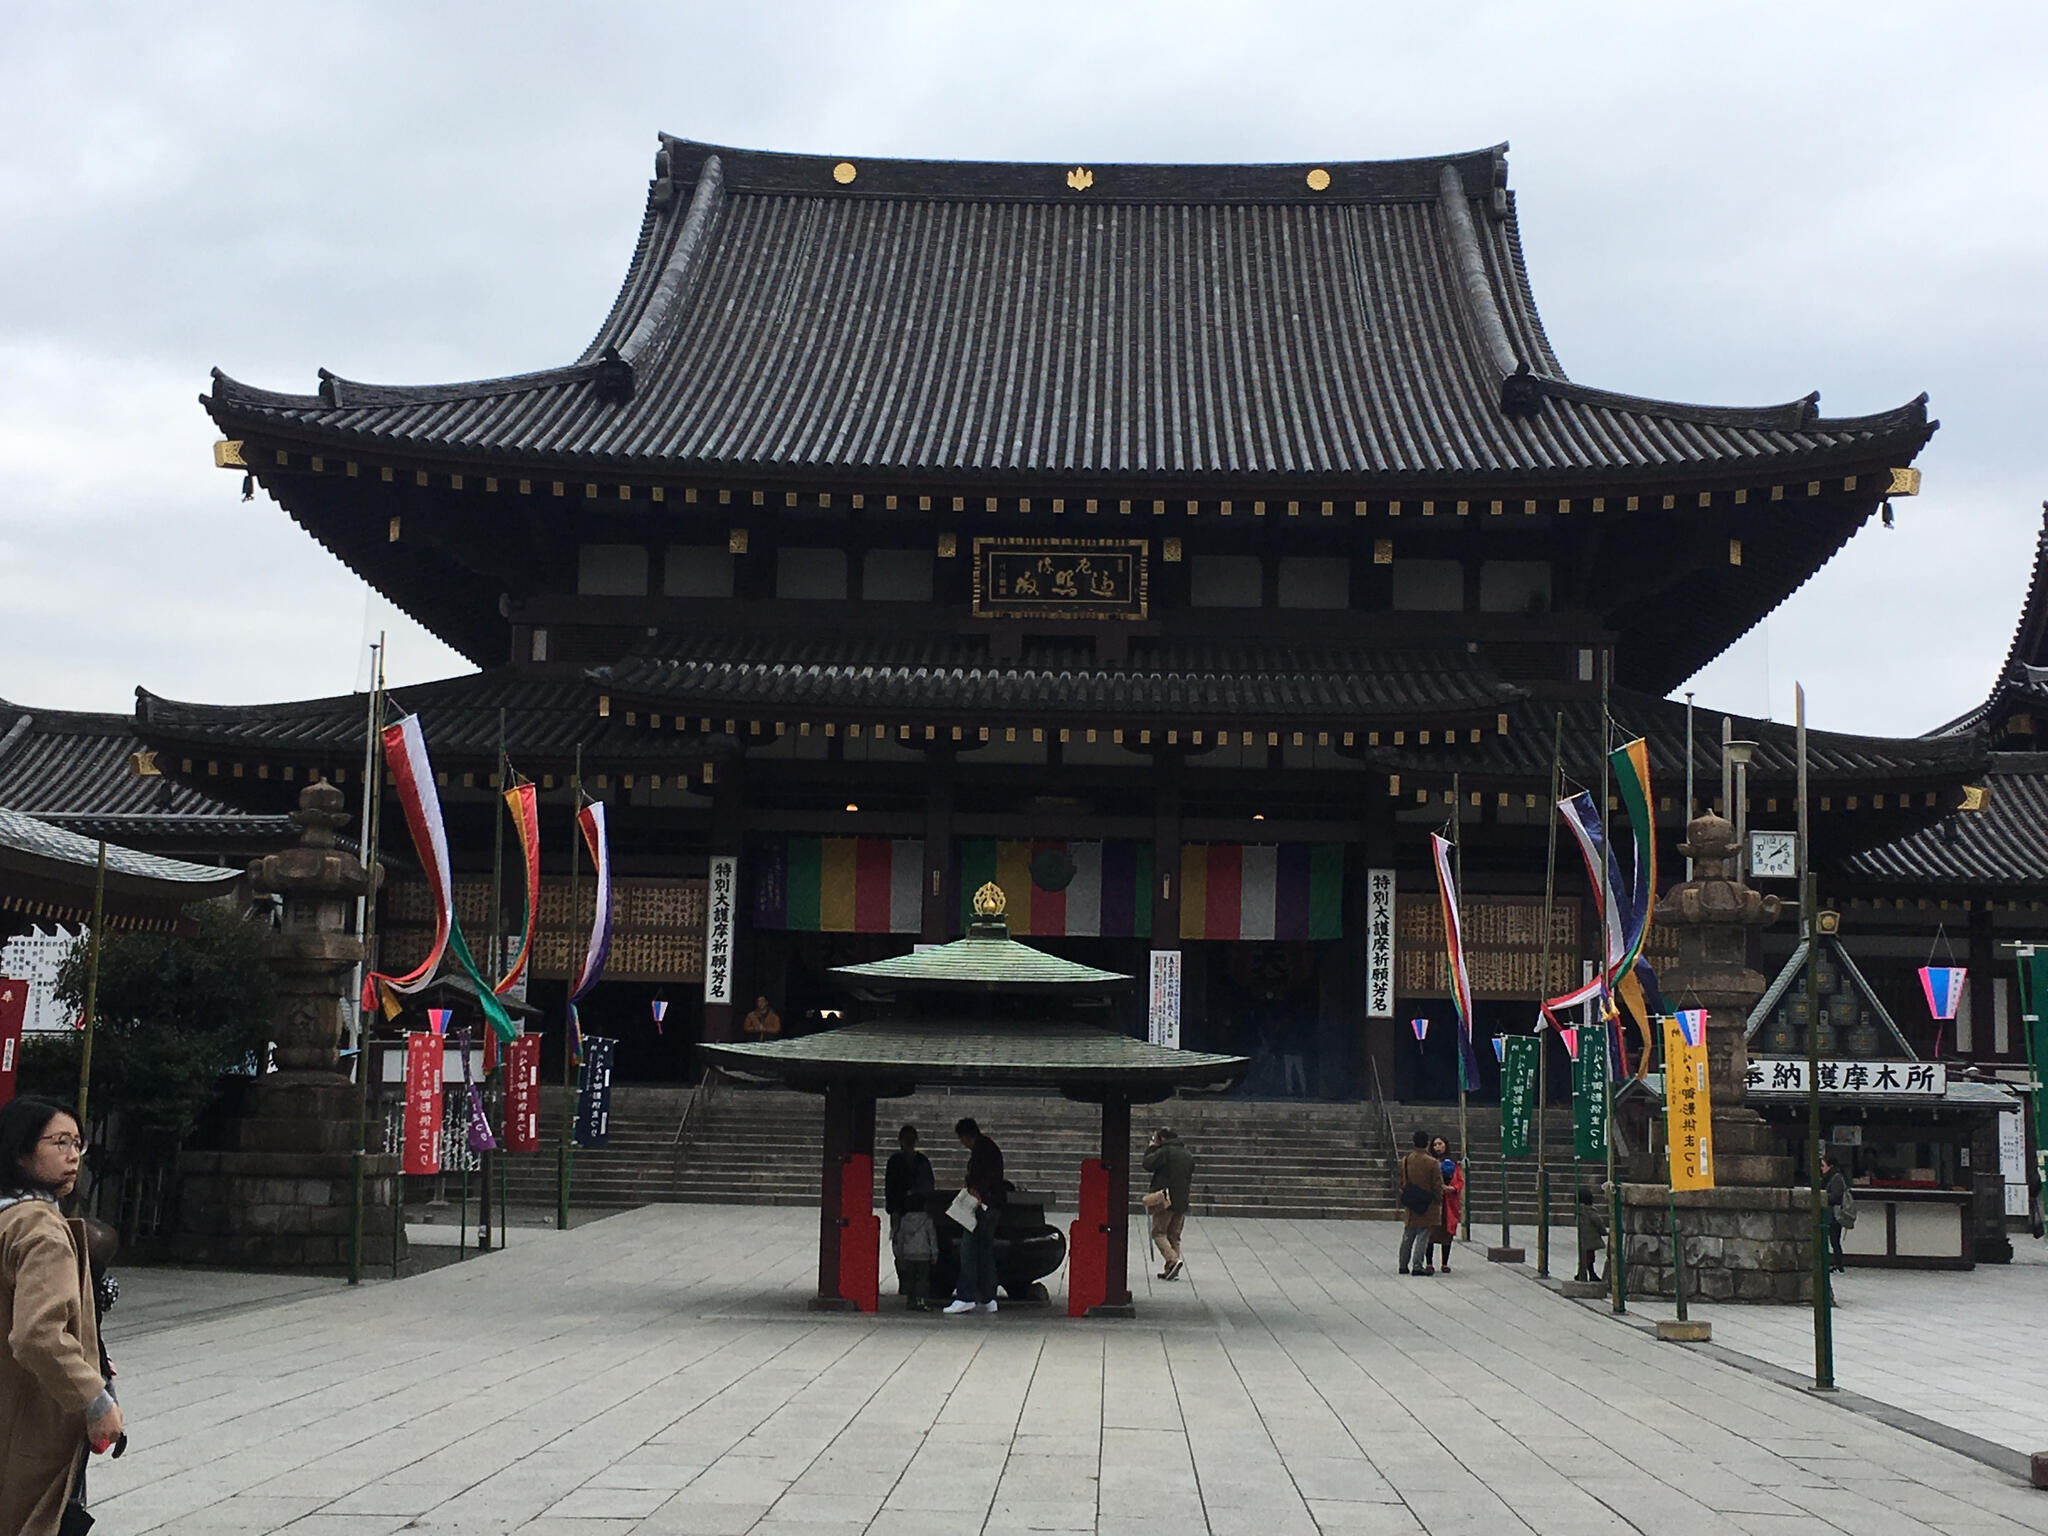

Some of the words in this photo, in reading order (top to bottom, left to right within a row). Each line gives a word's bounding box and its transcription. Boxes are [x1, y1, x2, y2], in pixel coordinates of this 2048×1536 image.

[710, 862, 732, 999] 特別大護摩祈願芳名
[1372, 874, 1391, 1012] 特別大護摩祈願芳名
